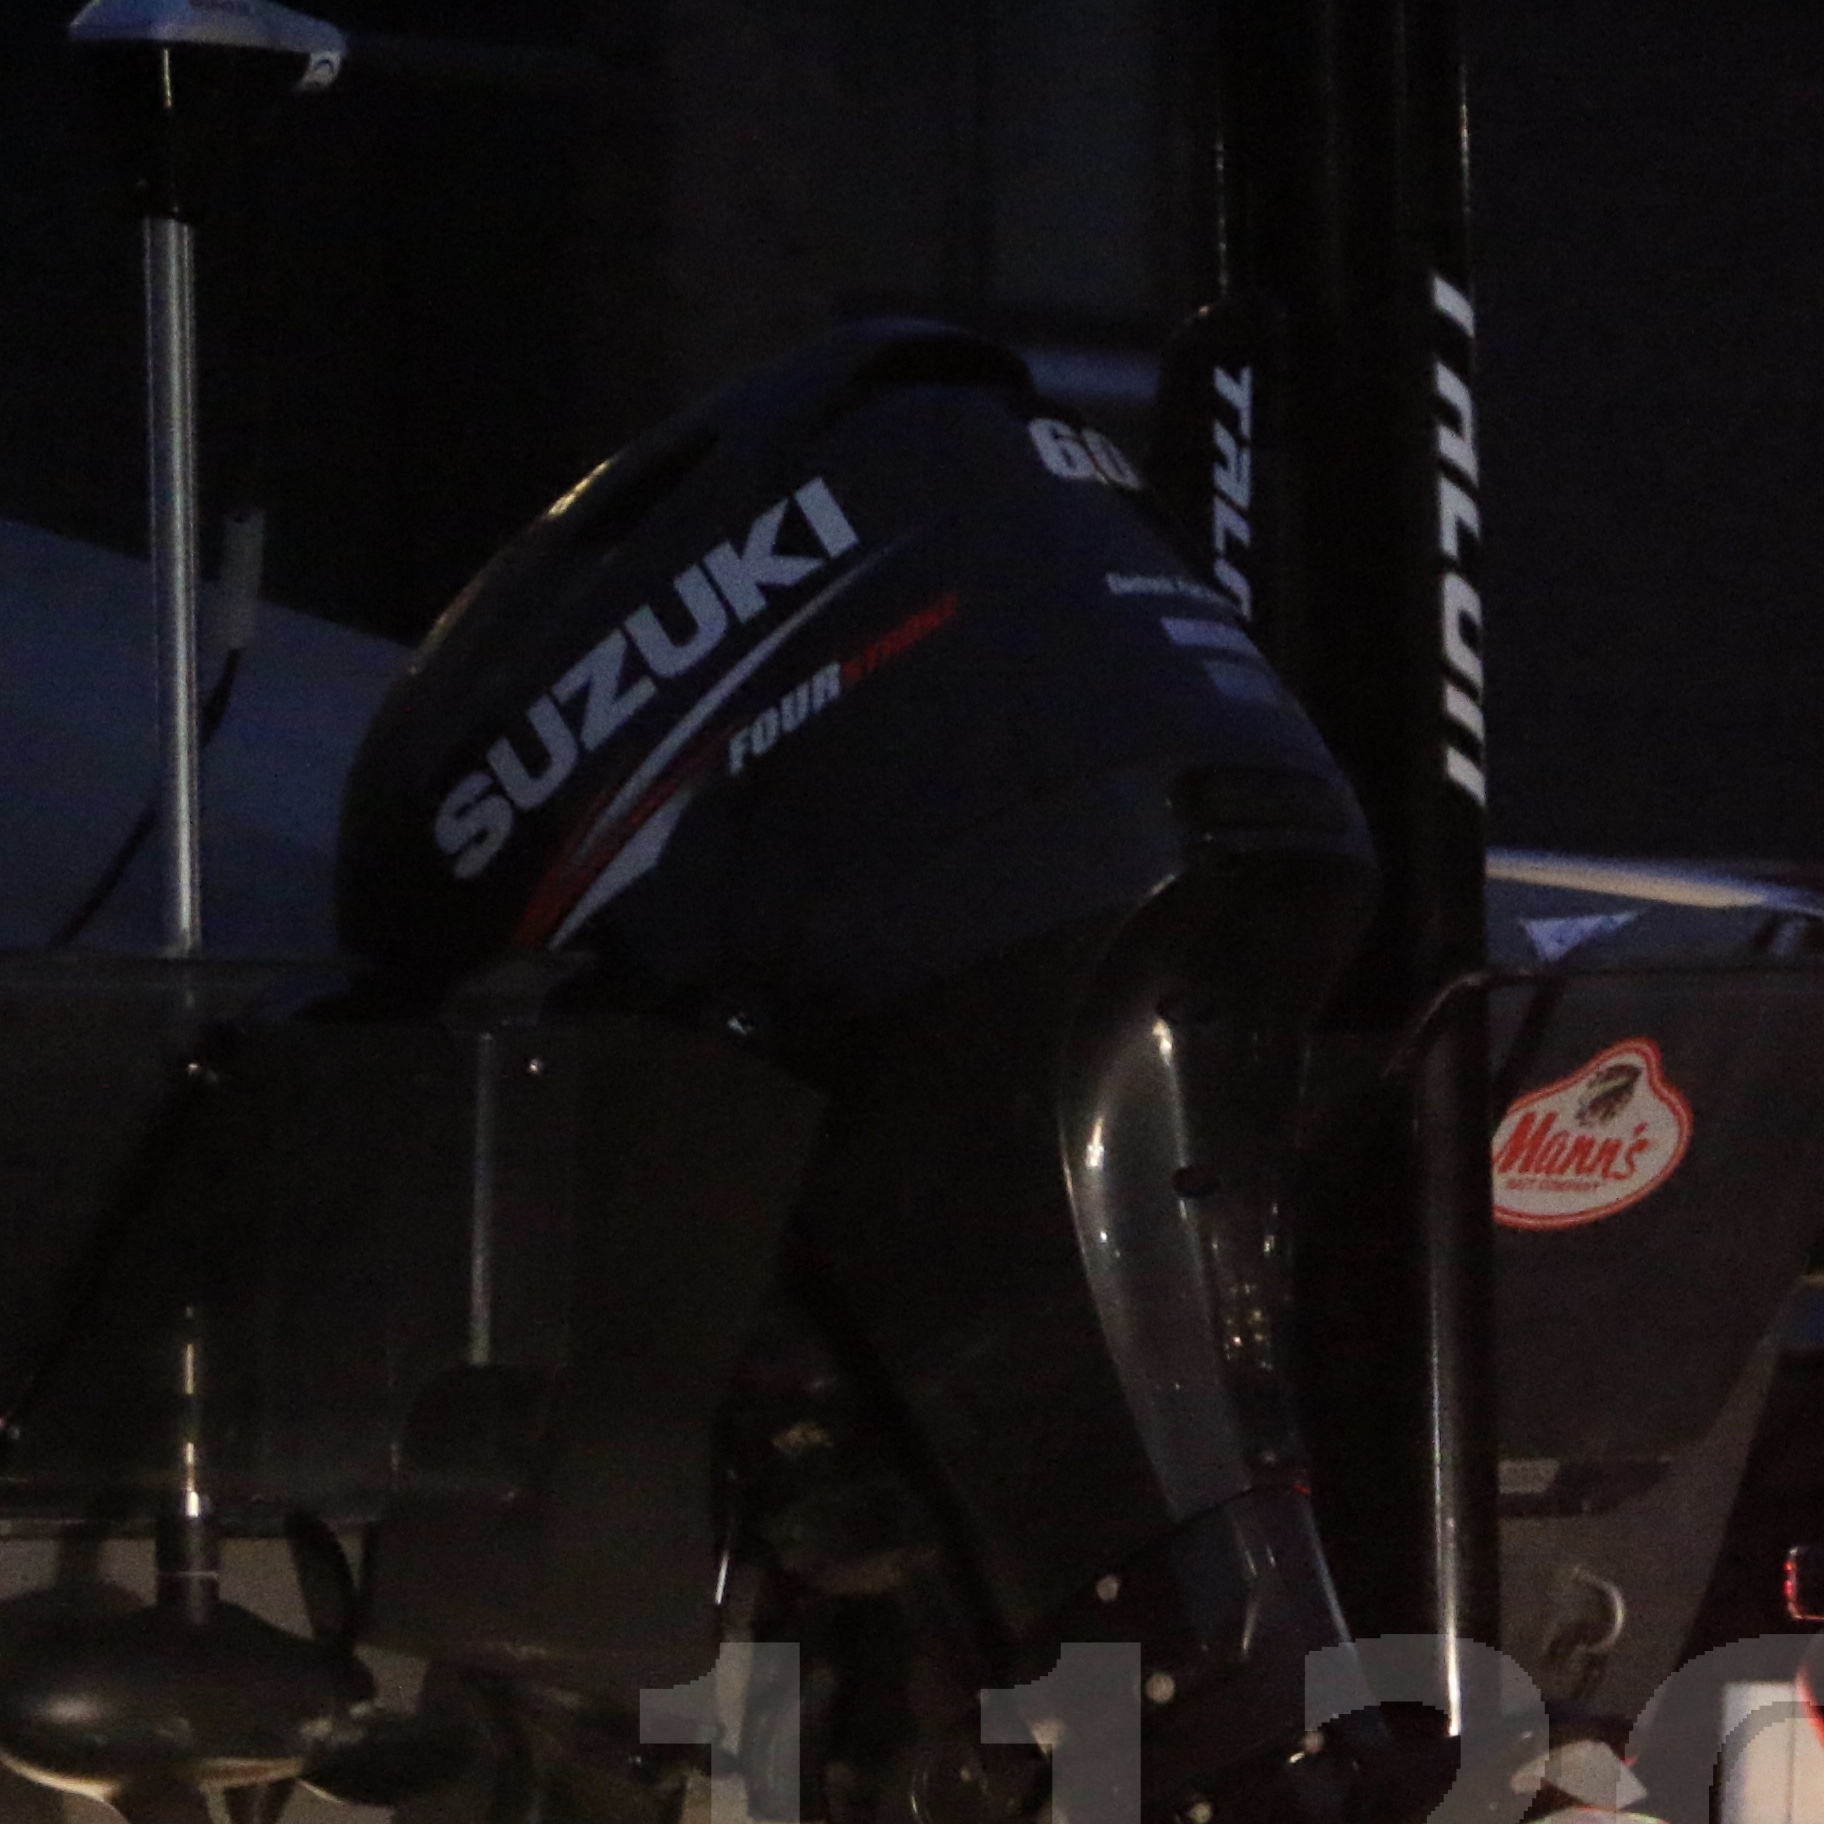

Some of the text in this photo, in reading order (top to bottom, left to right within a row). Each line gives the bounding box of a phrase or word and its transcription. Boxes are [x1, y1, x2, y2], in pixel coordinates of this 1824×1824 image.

[1028, 416, 1143, 492] 60
[433, 475, 861, 880] SUZUKI
[726, 661, 843, 777] FOUR
[1496, 1110, 1650, 1181] Mann's
